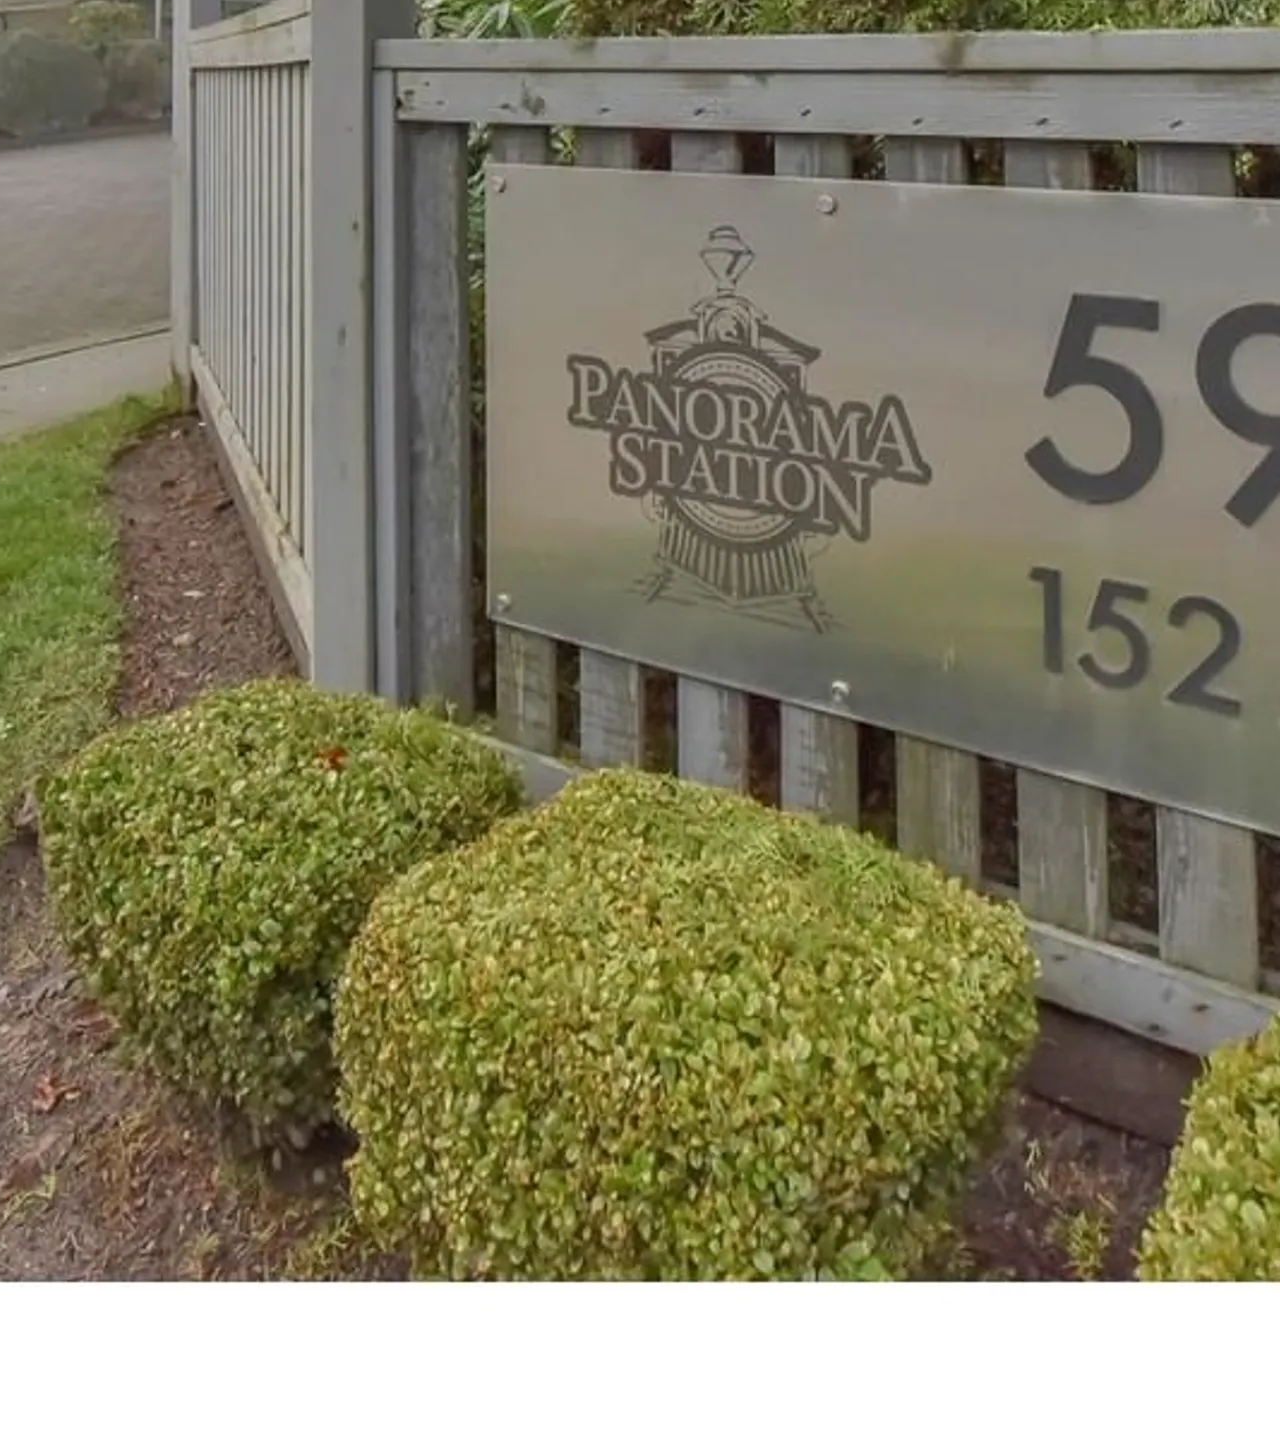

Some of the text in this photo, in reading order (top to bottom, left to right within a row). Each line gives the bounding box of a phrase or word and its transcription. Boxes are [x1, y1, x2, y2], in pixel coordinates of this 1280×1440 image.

[568, 356, 931, 482] PANORAMA
[610, 430, 872, 541] STATION
[1027, 564, 1243, 718] 152
